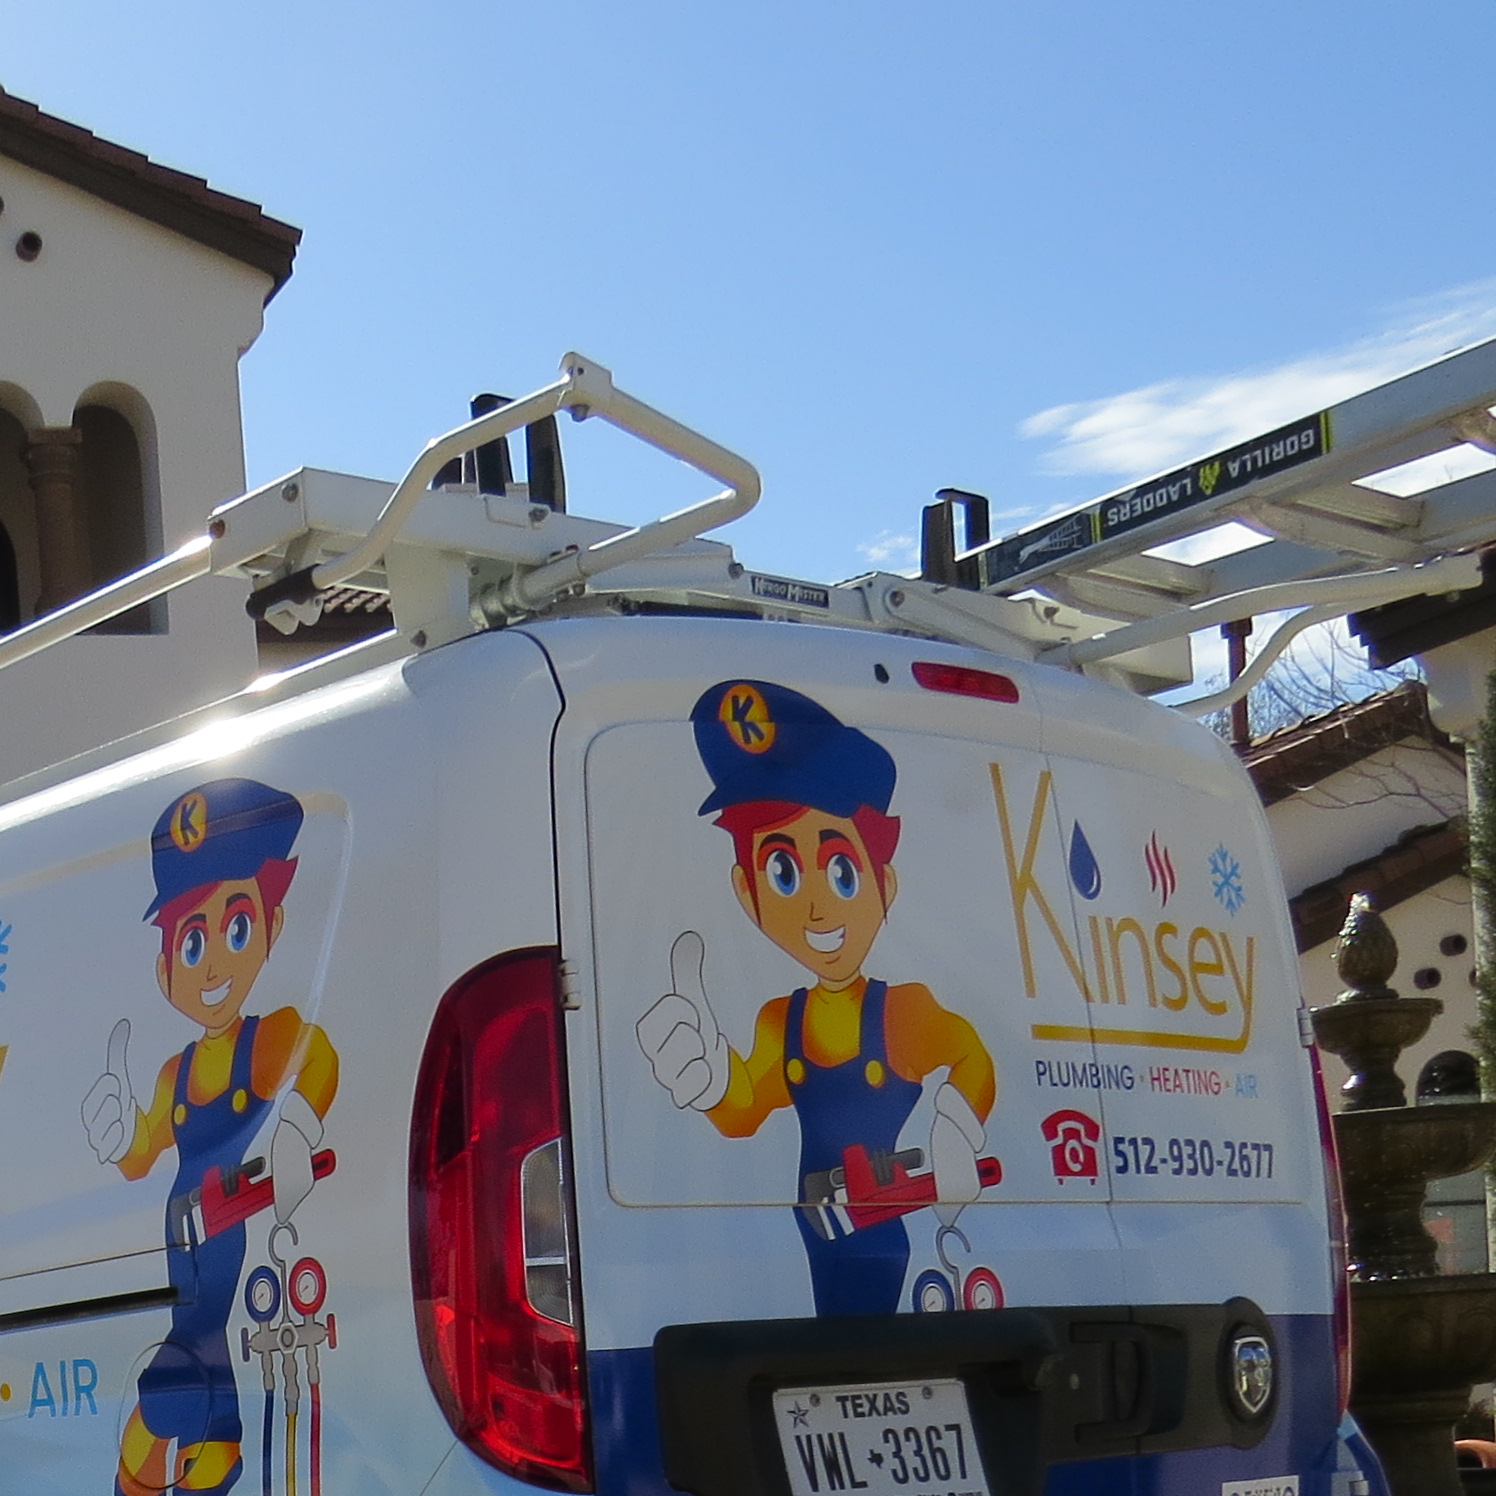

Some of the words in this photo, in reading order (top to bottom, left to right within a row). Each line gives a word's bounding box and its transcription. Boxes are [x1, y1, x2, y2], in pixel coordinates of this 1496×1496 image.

[1227, 428, 1315, 478] GORILLA
[1106, 477, 1193, 526] LADDERS
[731, 695, 765, 744] K
[180, 800, 199, 845] K
[988, 762, 1255, 1050] Kinsey
[1035, 1060, 1135, 1091] PLUMBING
[1149, 1066, 1222, 1096] HEATING
[1235, 1073, 1259, 1099] AIR
[1112, 1136, 1274, 1179] 512-930-2677
[28, 1358, 99, 1419] AIR
[835, 1391, 911, 1419] TEXAS
